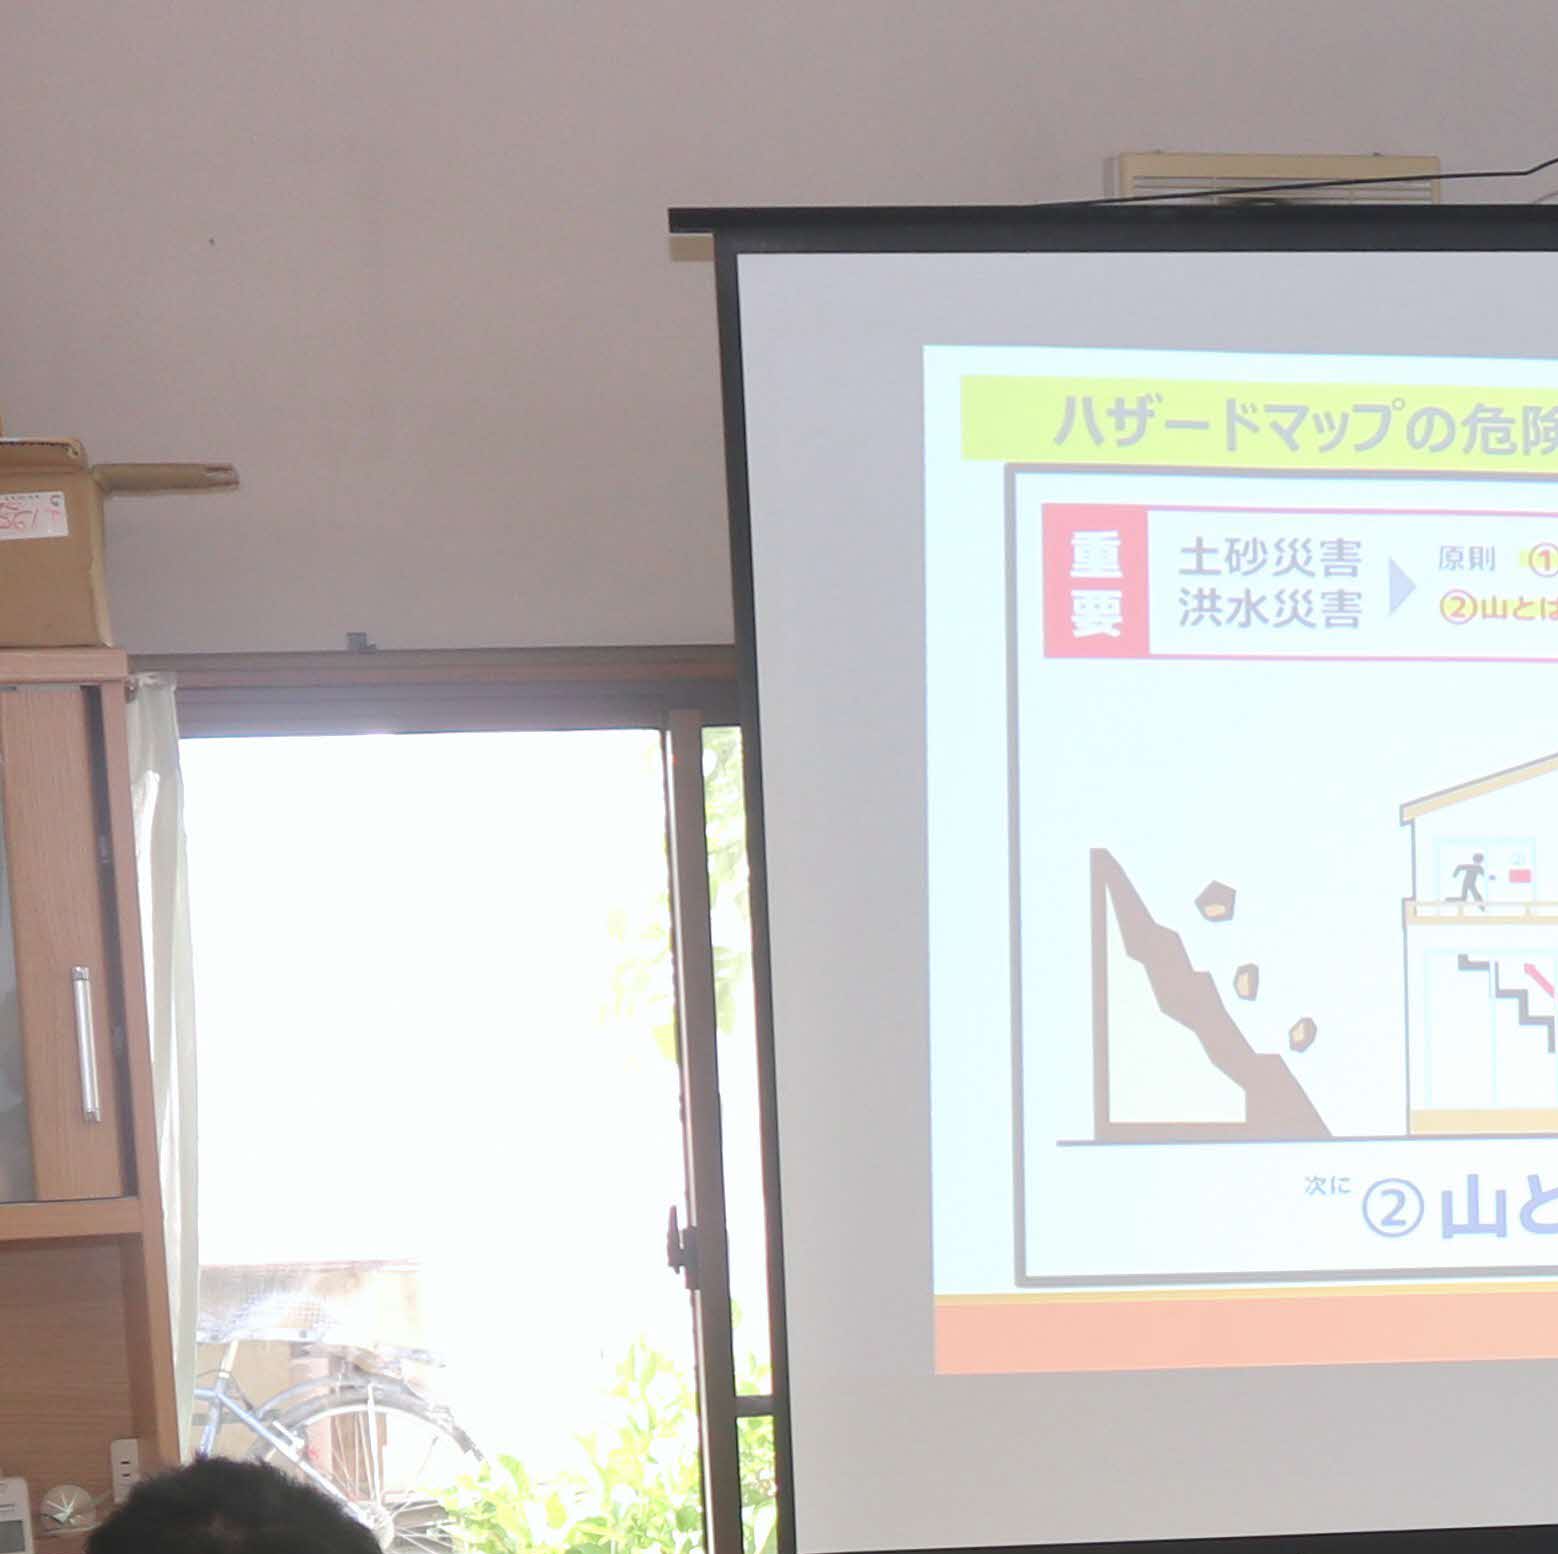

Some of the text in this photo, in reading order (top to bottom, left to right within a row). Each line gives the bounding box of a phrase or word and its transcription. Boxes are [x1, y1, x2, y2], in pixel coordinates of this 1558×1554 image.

[1178, 536, 1363, 580] 土砂災害
[1438, 545, 1497, 573] 原則
[1069, 529, 1124, 639] 重要
[1178, 587, 1363, 631] 洪水災害
[1304, 1174, 1351, 1198] 次に
